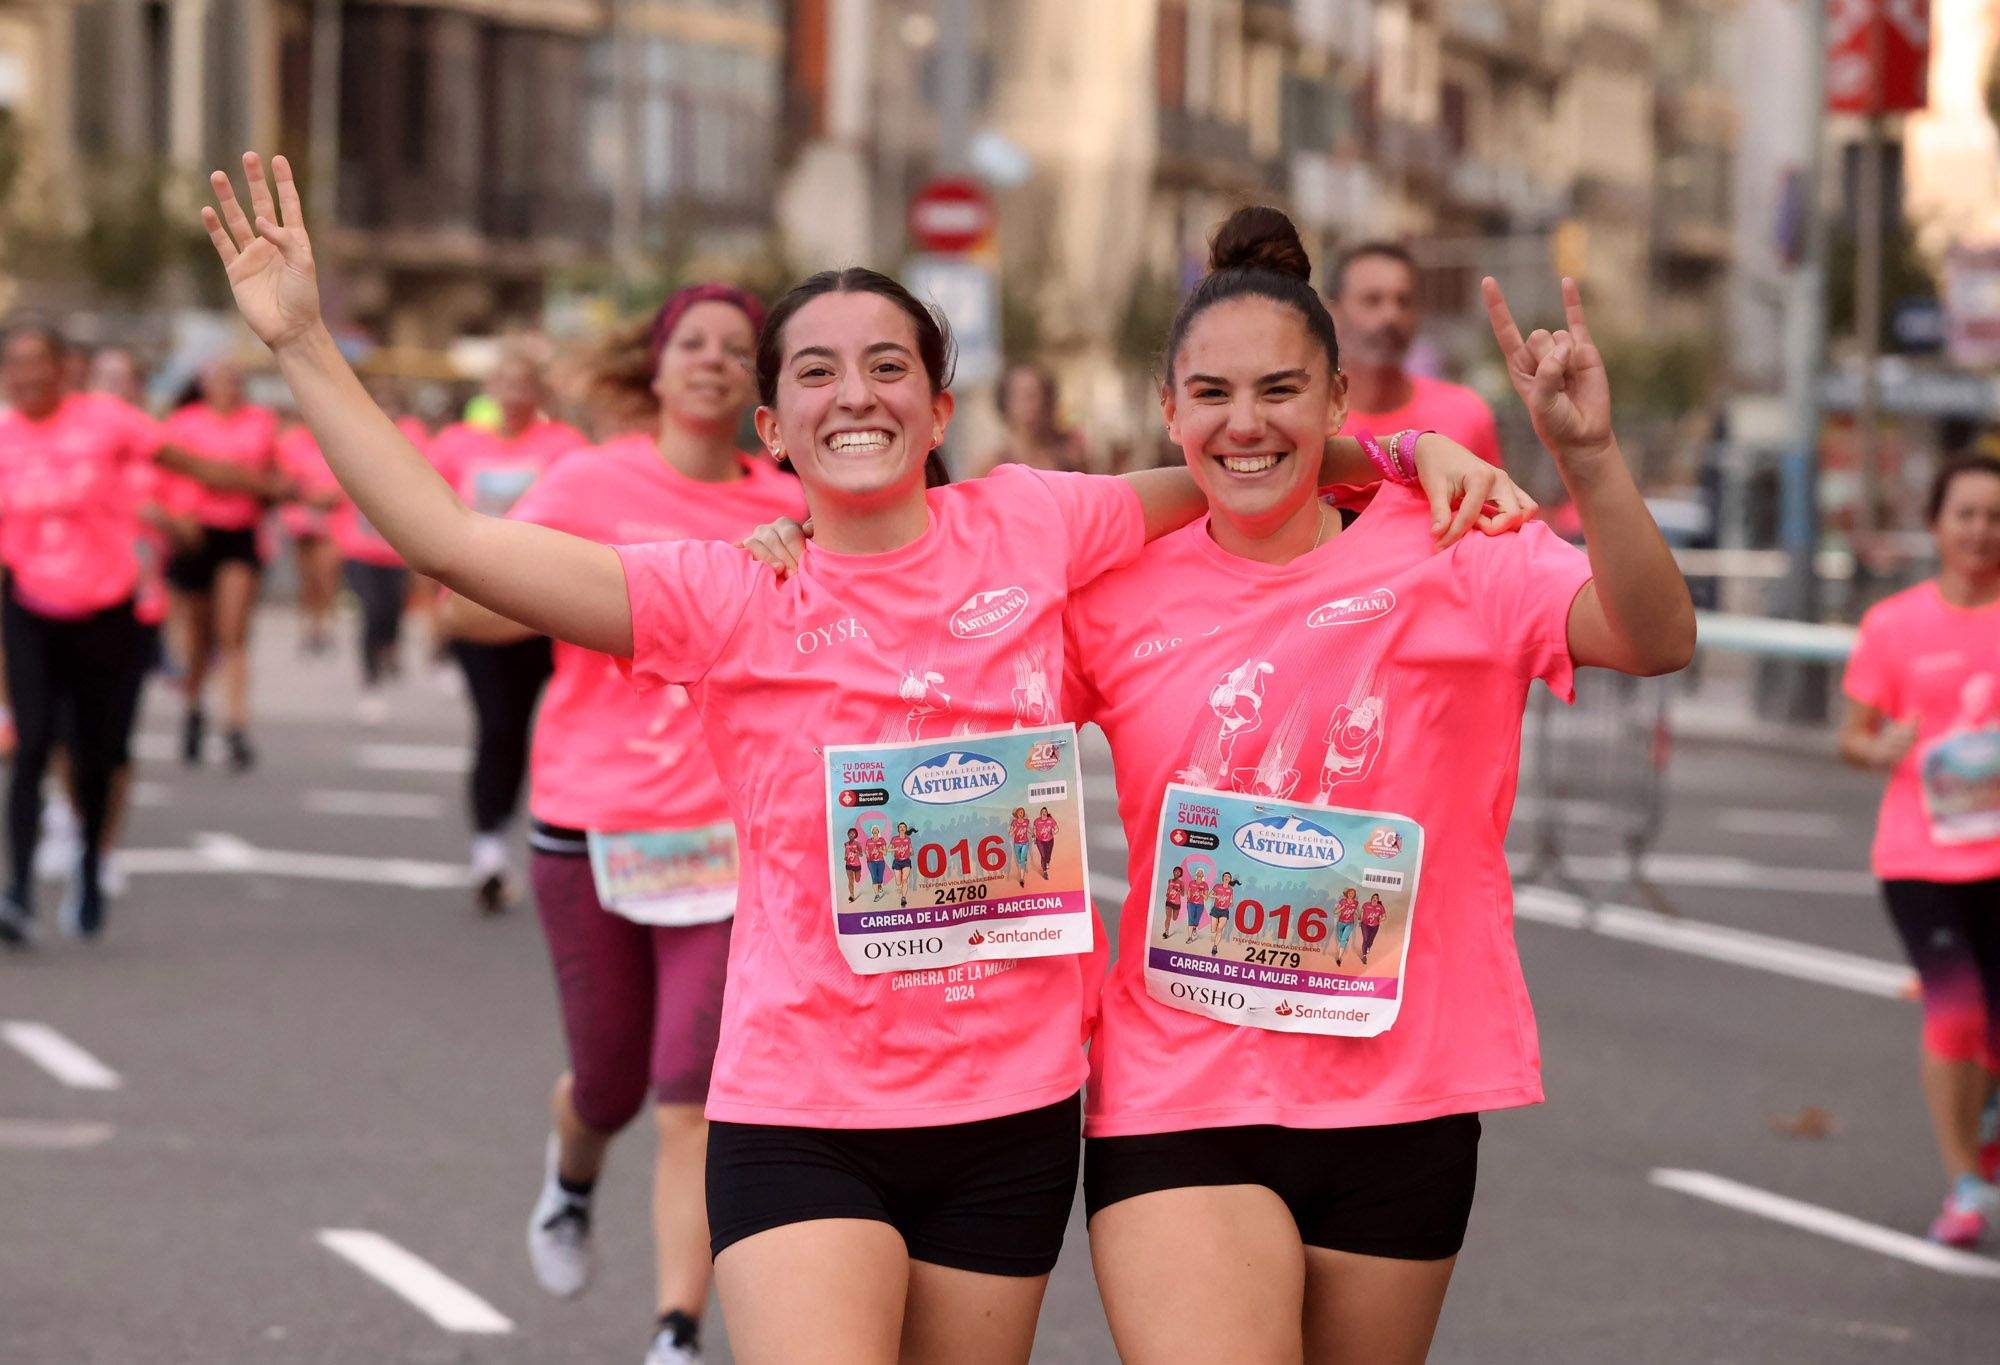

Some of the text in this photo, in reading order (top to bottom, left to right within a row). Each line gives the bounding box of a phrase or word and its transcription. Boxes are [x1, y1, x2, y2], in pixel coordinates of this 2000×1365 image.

[957, 594, 1025, 635] ASTURIANA
[843, 770, 885, 784] SUMA
[854, 762, 885, 770] DORSAL
[925, 765, 996, 778] CENTRAL LECHERA
[910, 772, 1000, 796] ASTURIANA
[1178, 811, 1217, 828] SUMA
[1179, 802, 1220, 816] TU DORSAL
[1240, 829, 1336, 861] ASTURIANA
[917, 835, 1006, 879] 016
[935, 884, 987, 905] 24780
[860, 897, 1063, 928] CARRERA DE LA MUJER BARCELONA
[1235, 899, 1328, 943] 016
[987, 928, 1063, 944] Santander
[864, 937, 943, 960] OYSHO
[1245, 946, 1300, 968] 24779
[891, 958, 1018, 991] CARRERA DE LA MUJER
[1170, 955, 1376, 992] CARRERA DE LA MUJER BARCELONA
[944, 984, 976, 1003] 2024
[1170, 982, 1245, 1010] OYSHO
[1295, 1005, 1371, 1022] Santander
